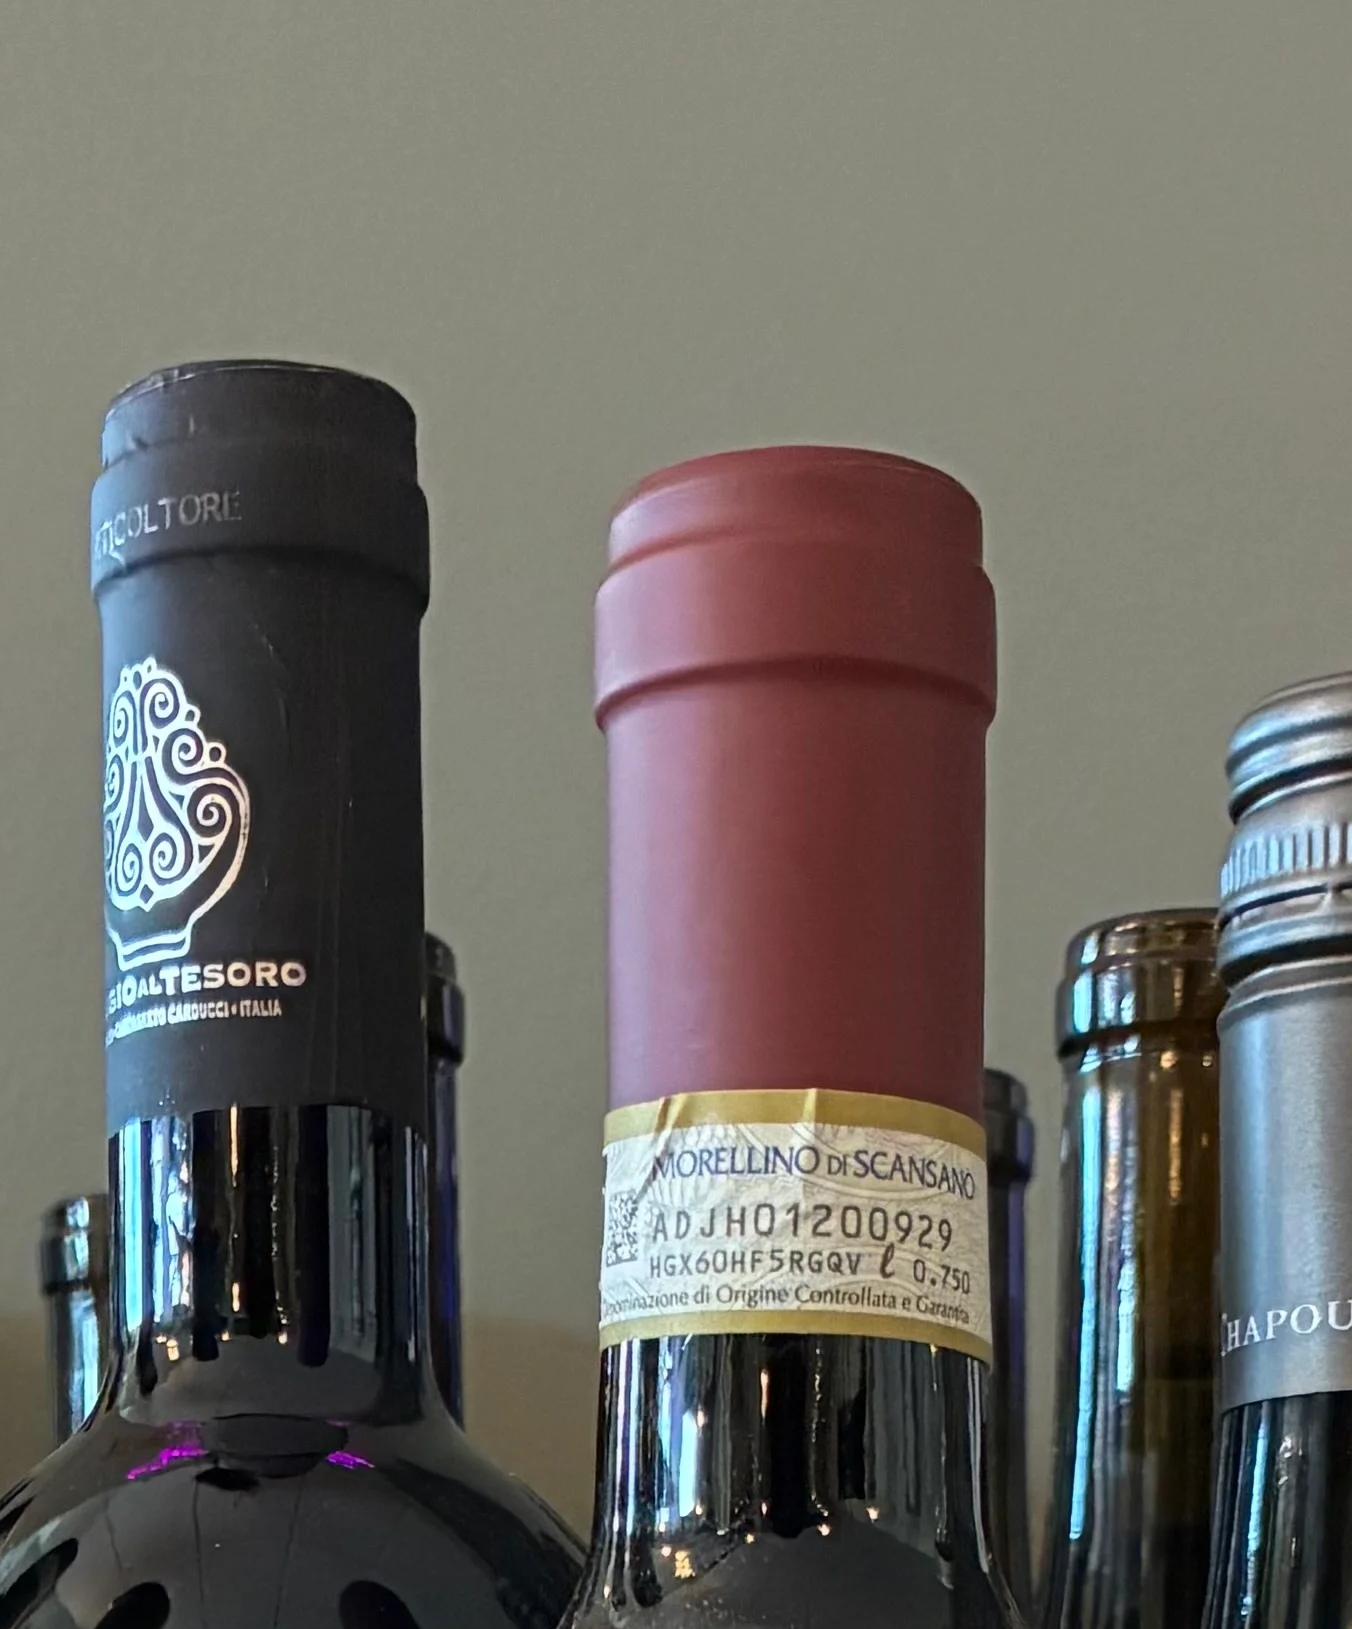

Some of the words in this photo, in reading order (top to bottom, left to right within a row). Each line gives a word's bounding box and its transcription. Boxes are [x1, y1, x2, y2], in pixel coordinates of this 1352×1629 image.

[239, 1000, 282, 1018] ITALIA
[652, 1146, 820, 1181] MORELLINO
[827, 1154, 848, 1176] DI
[853, 1150, 976, 1200] SCANSANO
[653, 1203, 953, 1253] ADJH01200929
[913, 1259, 971, 1294] 0.750
[694, 1285, 711, 1304] di
[716, 1285, 789, 1308] Origine
[795, 1284, 897, 1310] Controllata
